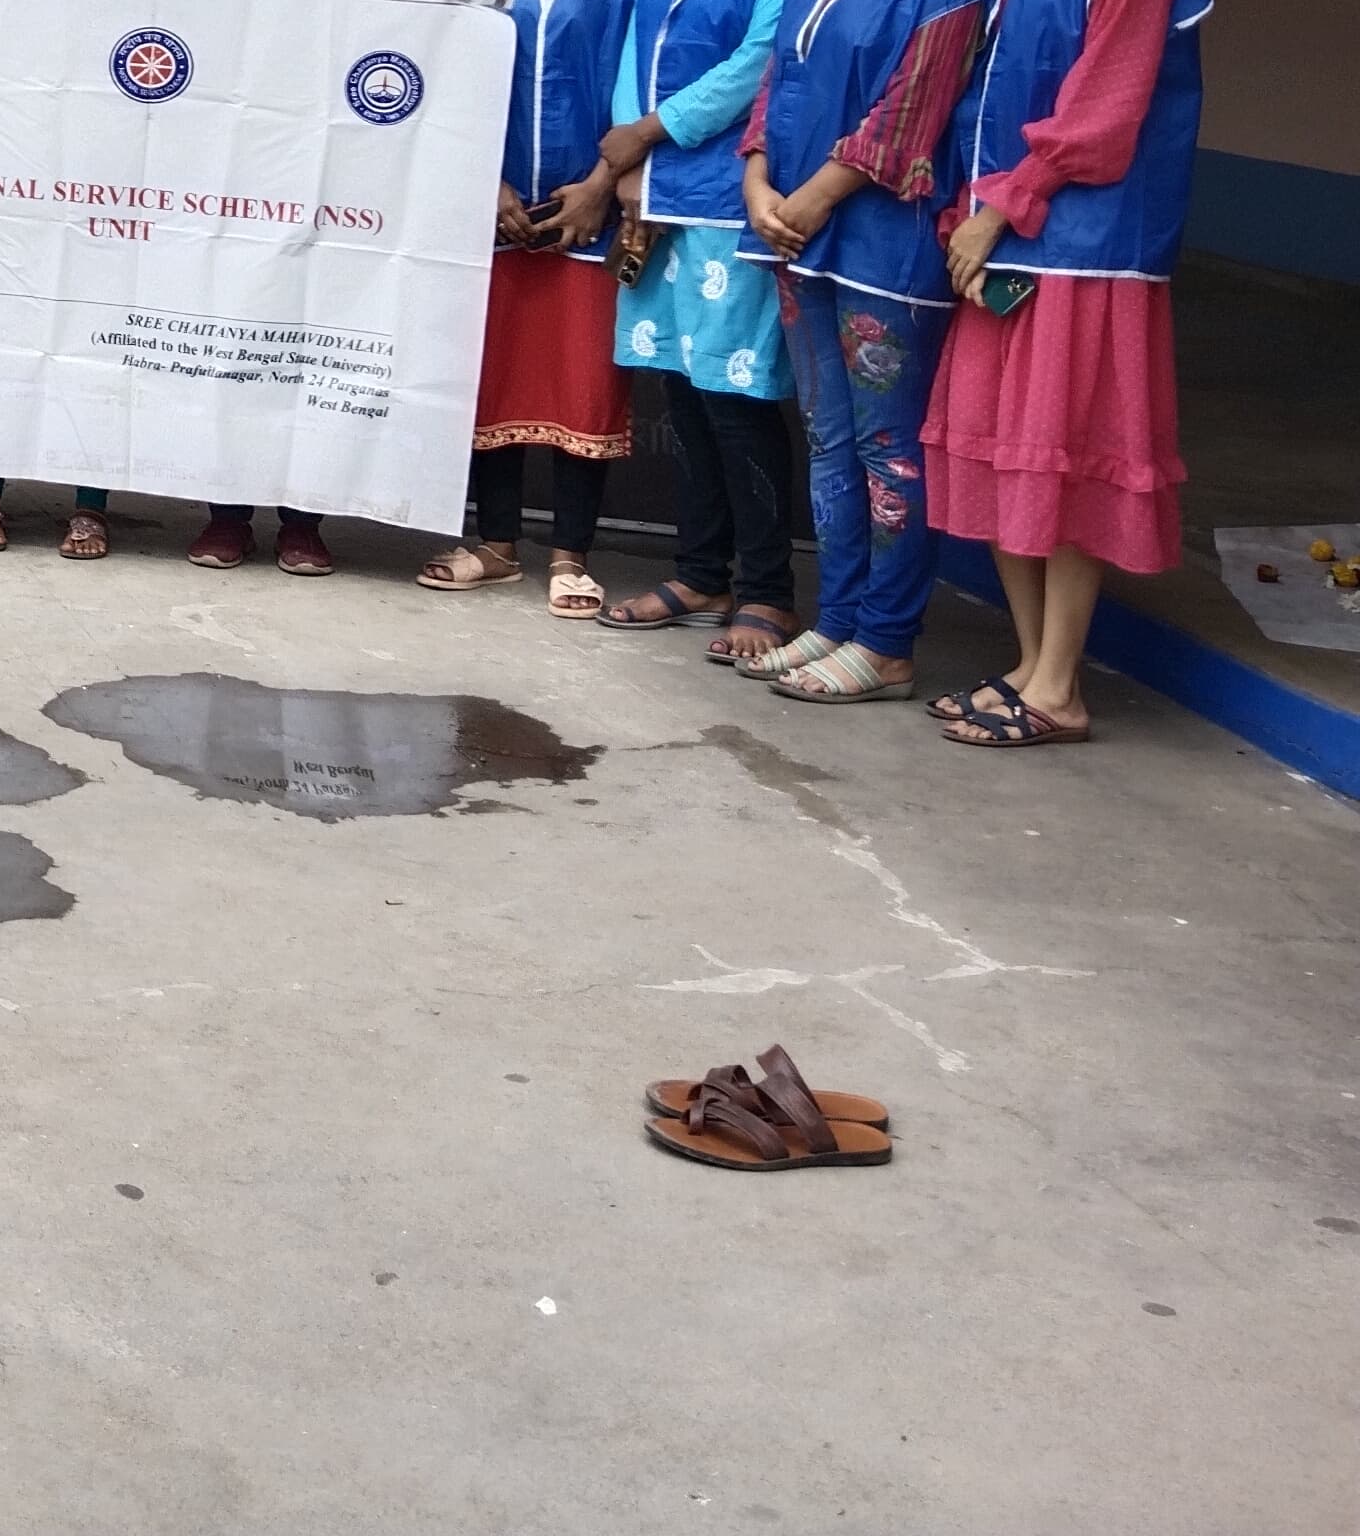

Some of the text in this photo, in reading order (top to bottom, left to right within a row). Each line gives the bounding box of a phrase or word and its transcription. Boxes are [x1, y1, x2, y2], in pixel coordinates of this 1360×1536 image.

[52, 180, 174, 211] SERVICE
[183, 192, 304, 225] SCHEME
[314, 204, 383, 236] (NSS)
[88, 216, 156, 241] UNIT
[91, 331, 392, 379] (Affiliated to the West Bengal State University)
[125, 313, 394, 356] SREE CHAITANYA MAHAVIDYALAYA
[122, 354, 167, 371] Habra-
[268, 371, 305, 384] North
[308, 373, 326, 387] 24
[328, 377, 390, 398] Parganas
[307, 394, 390, 419] West Bengal
